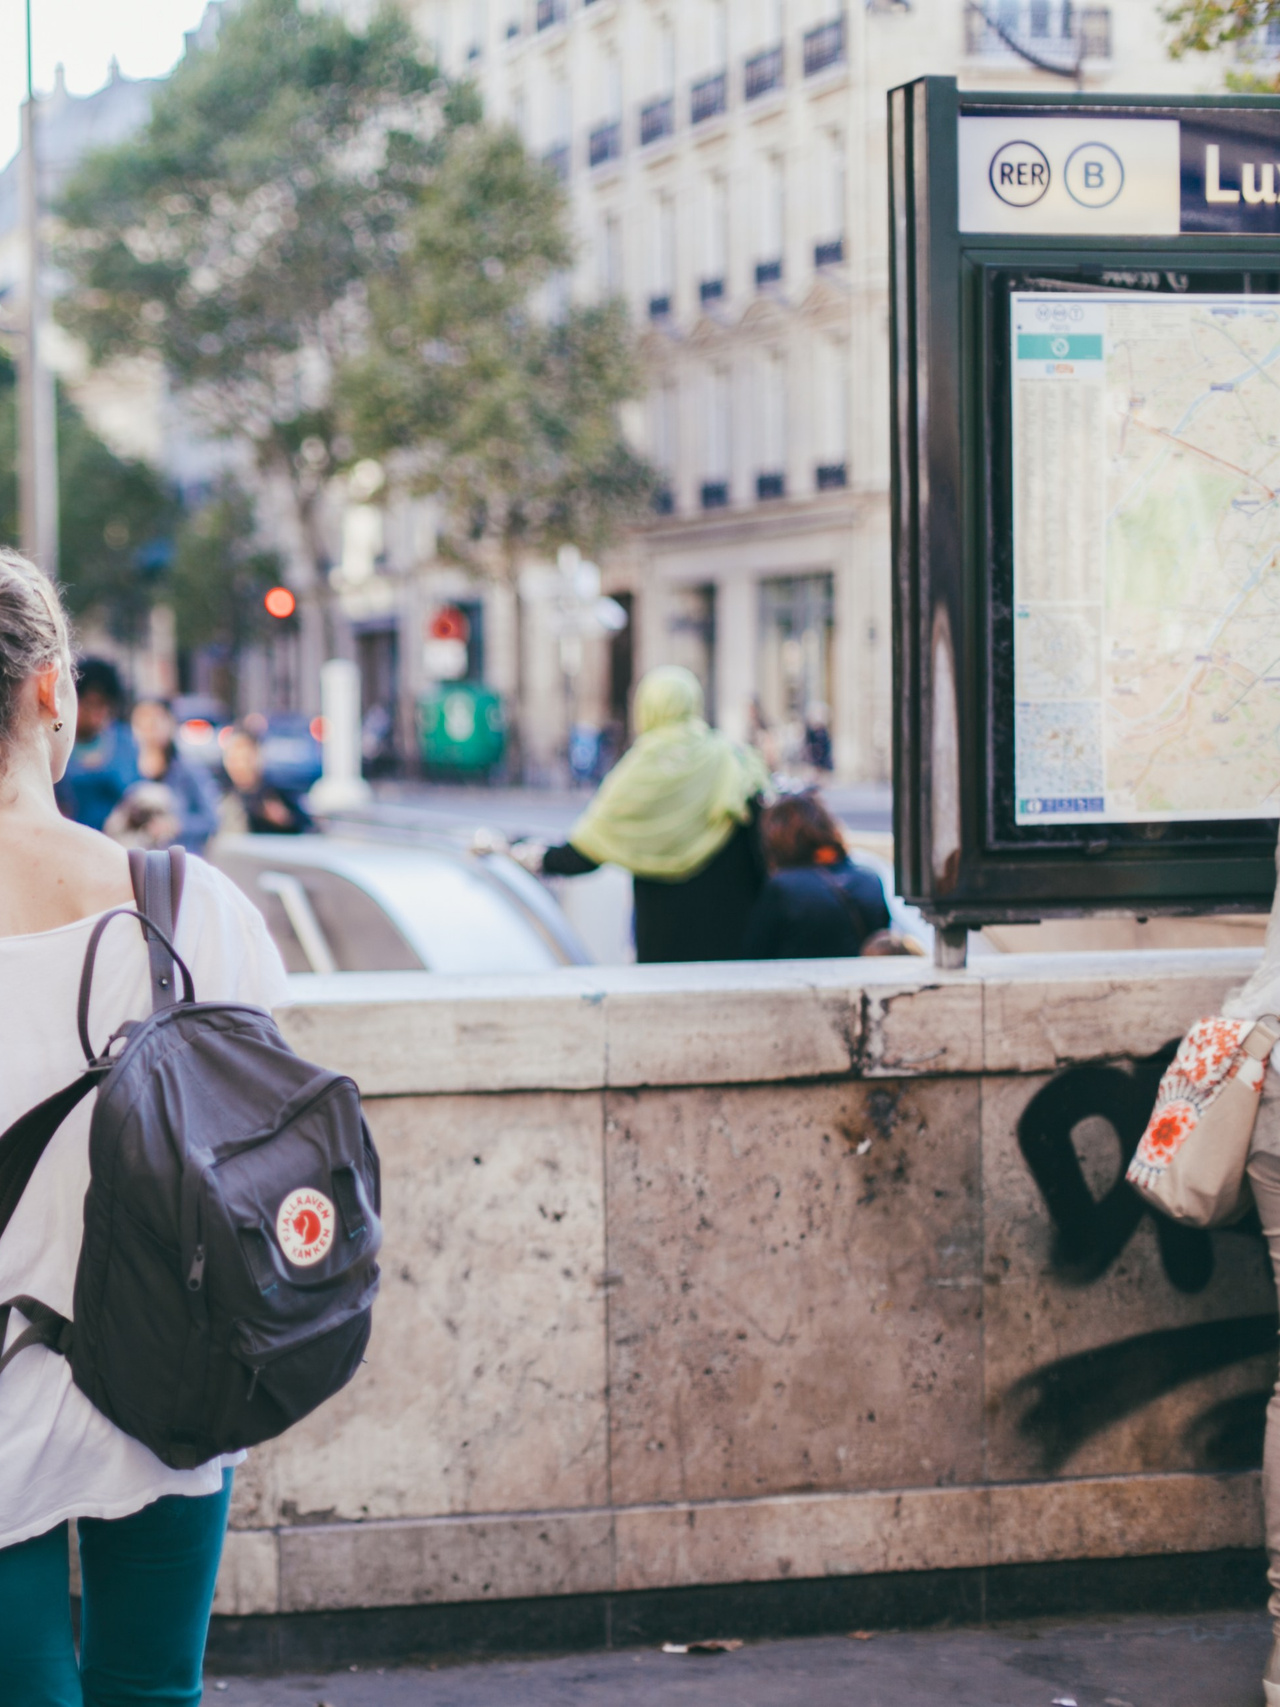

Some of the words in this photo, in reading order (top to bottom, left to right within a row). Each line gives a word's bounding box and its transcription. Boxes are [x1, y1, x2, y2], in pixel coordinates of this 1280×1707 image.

[1000, 162, 1045, 186] RER
[1084, 161, 1105, 189] B
[1205, 143, 1280, 204] Lu
